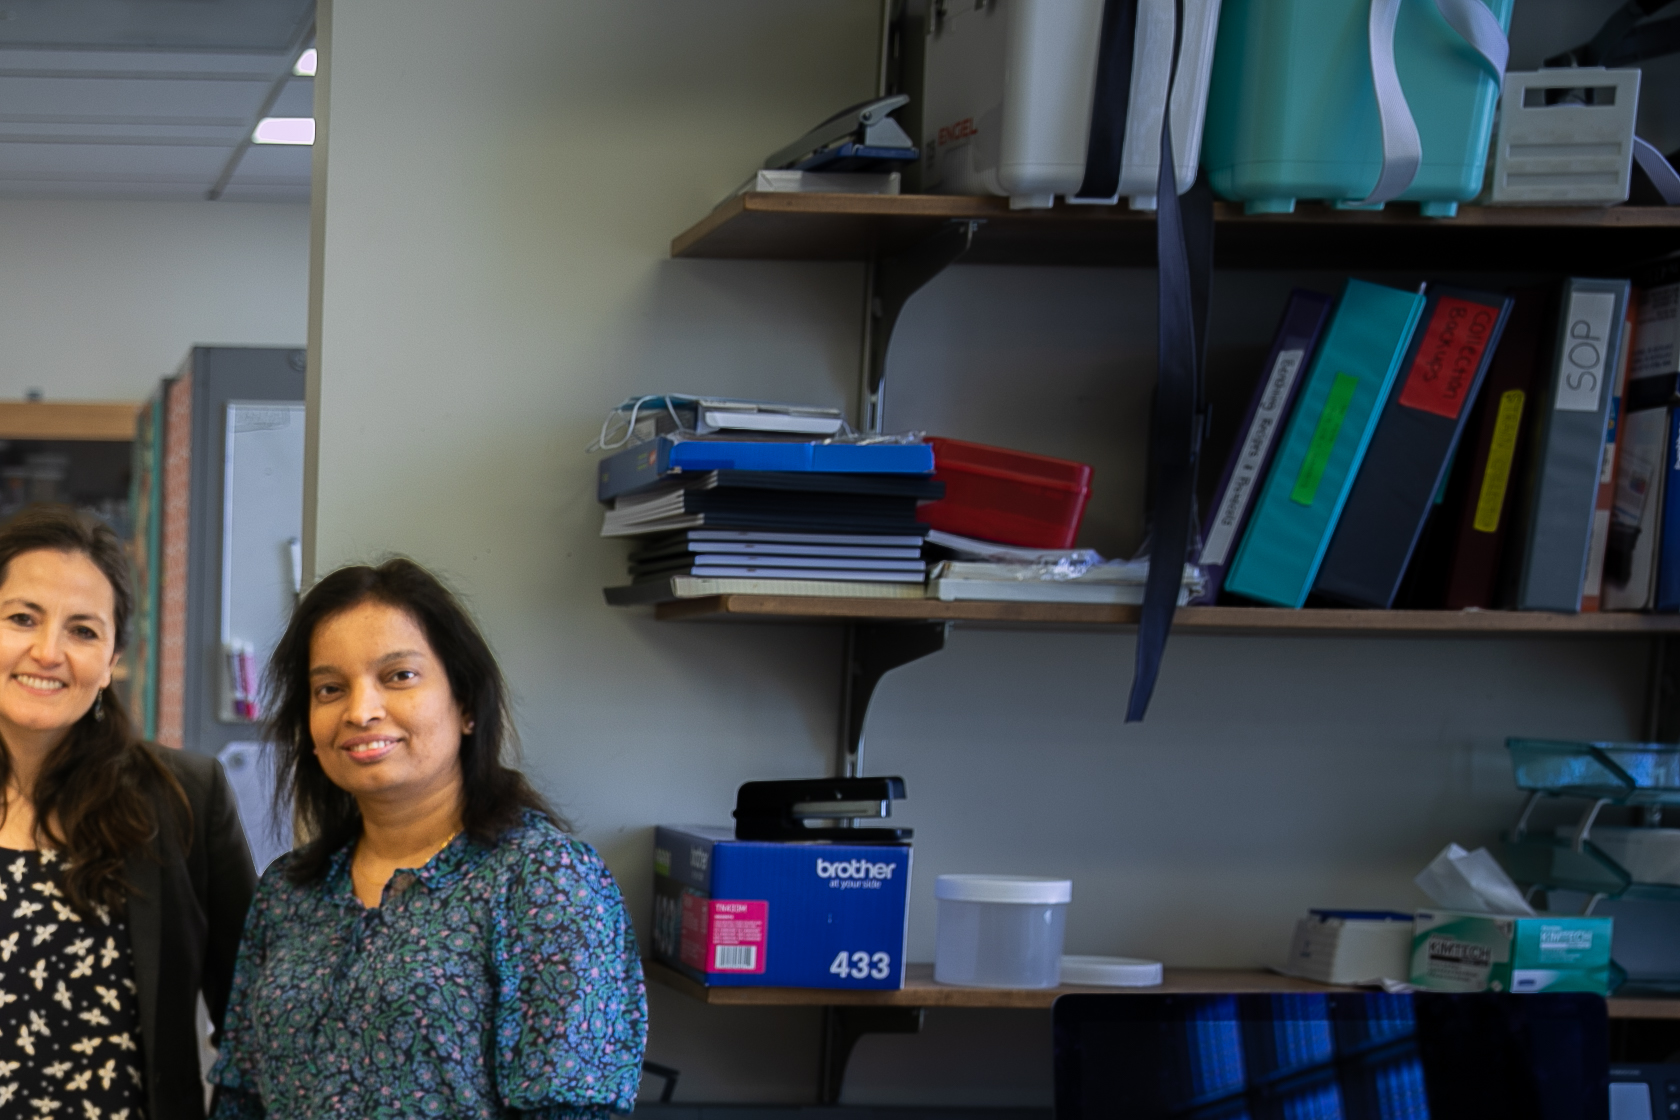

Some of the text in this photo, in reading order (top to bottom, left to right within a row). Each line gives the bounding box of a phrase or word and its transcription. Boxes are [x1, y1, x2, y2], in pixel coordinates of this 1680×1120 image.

[938, 117, 978, 147] ENGEL
[1565, 319, 1601, 392] SOP
[816, 857, 897, 880] brother
[829, 879, 882, 890] at your side
[1429, 941, 1491, 960] KIMTECH
[829, 950, 891, 980] 433
